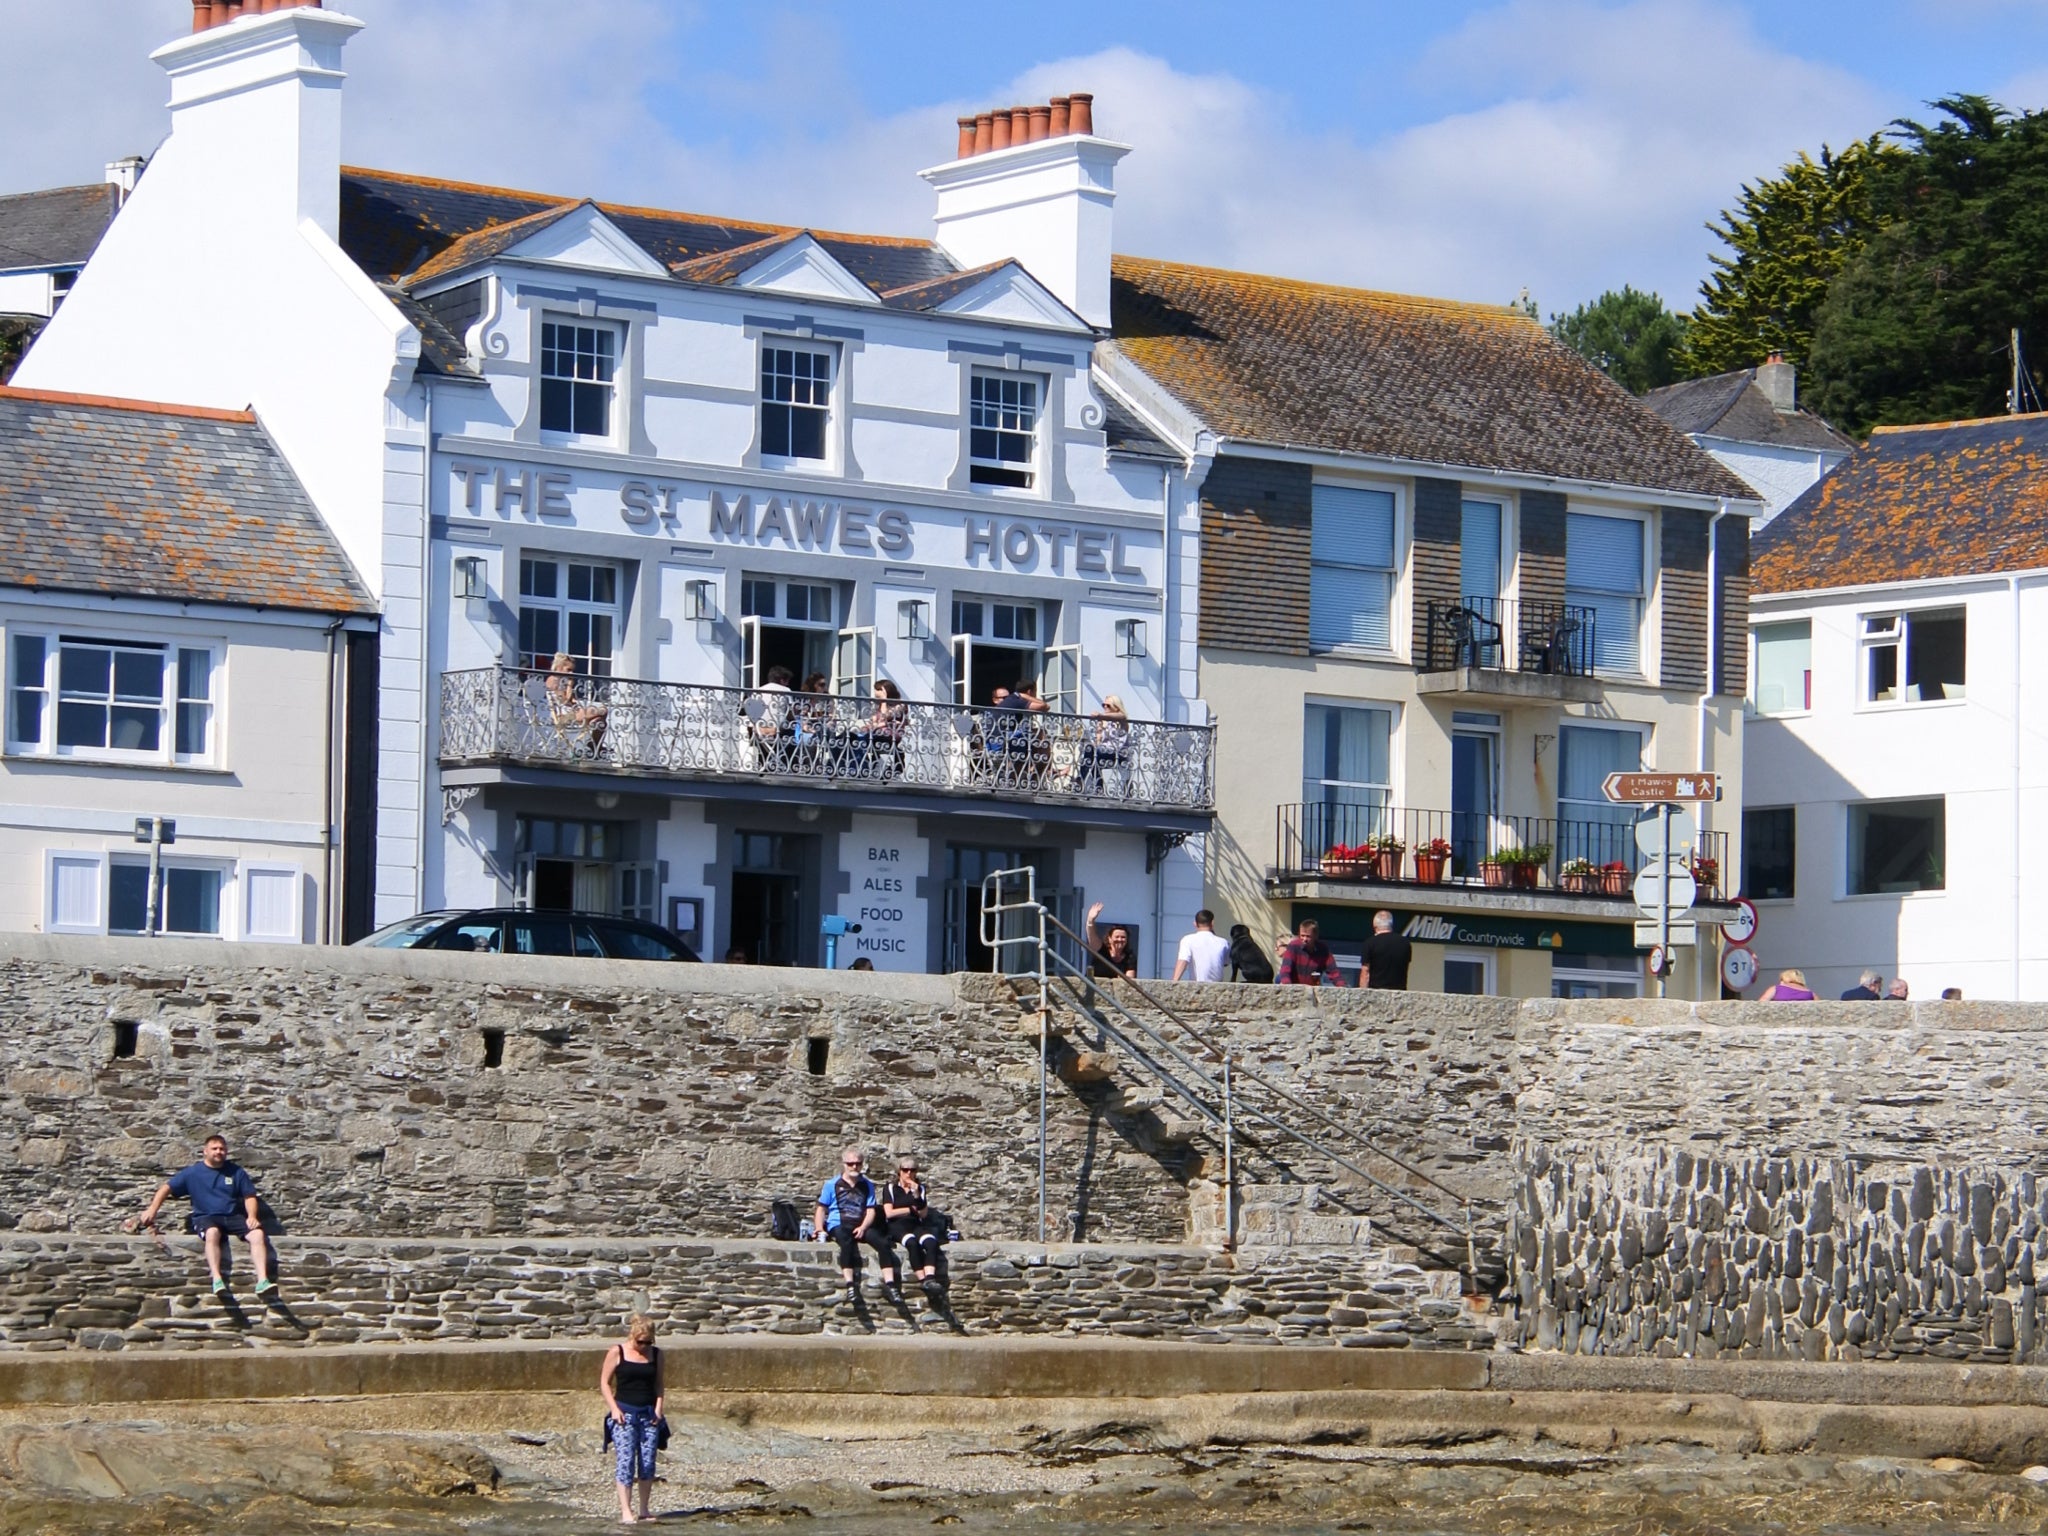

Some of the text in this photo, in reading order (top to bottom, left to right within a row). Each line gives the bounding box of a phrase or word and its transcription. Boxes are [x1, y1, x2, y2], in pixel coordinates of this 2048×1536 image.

[451, 461, 572, 517] THE
[708, 489, 909, 551] MAWES
[963, 517, 1142, 577] HOTEL
[1637, 778, 1673, 786] Mawes
[1631, 787, 1665, 796] Castle
[868, 847, 900, 862] BAR
[863, 878, 903, 892] ALES
[861, 907, 903, 921] FOOD
[1402, 914, 1526, 947] Miller Countrywide
[856, 937, 906, 953] MUSIC
